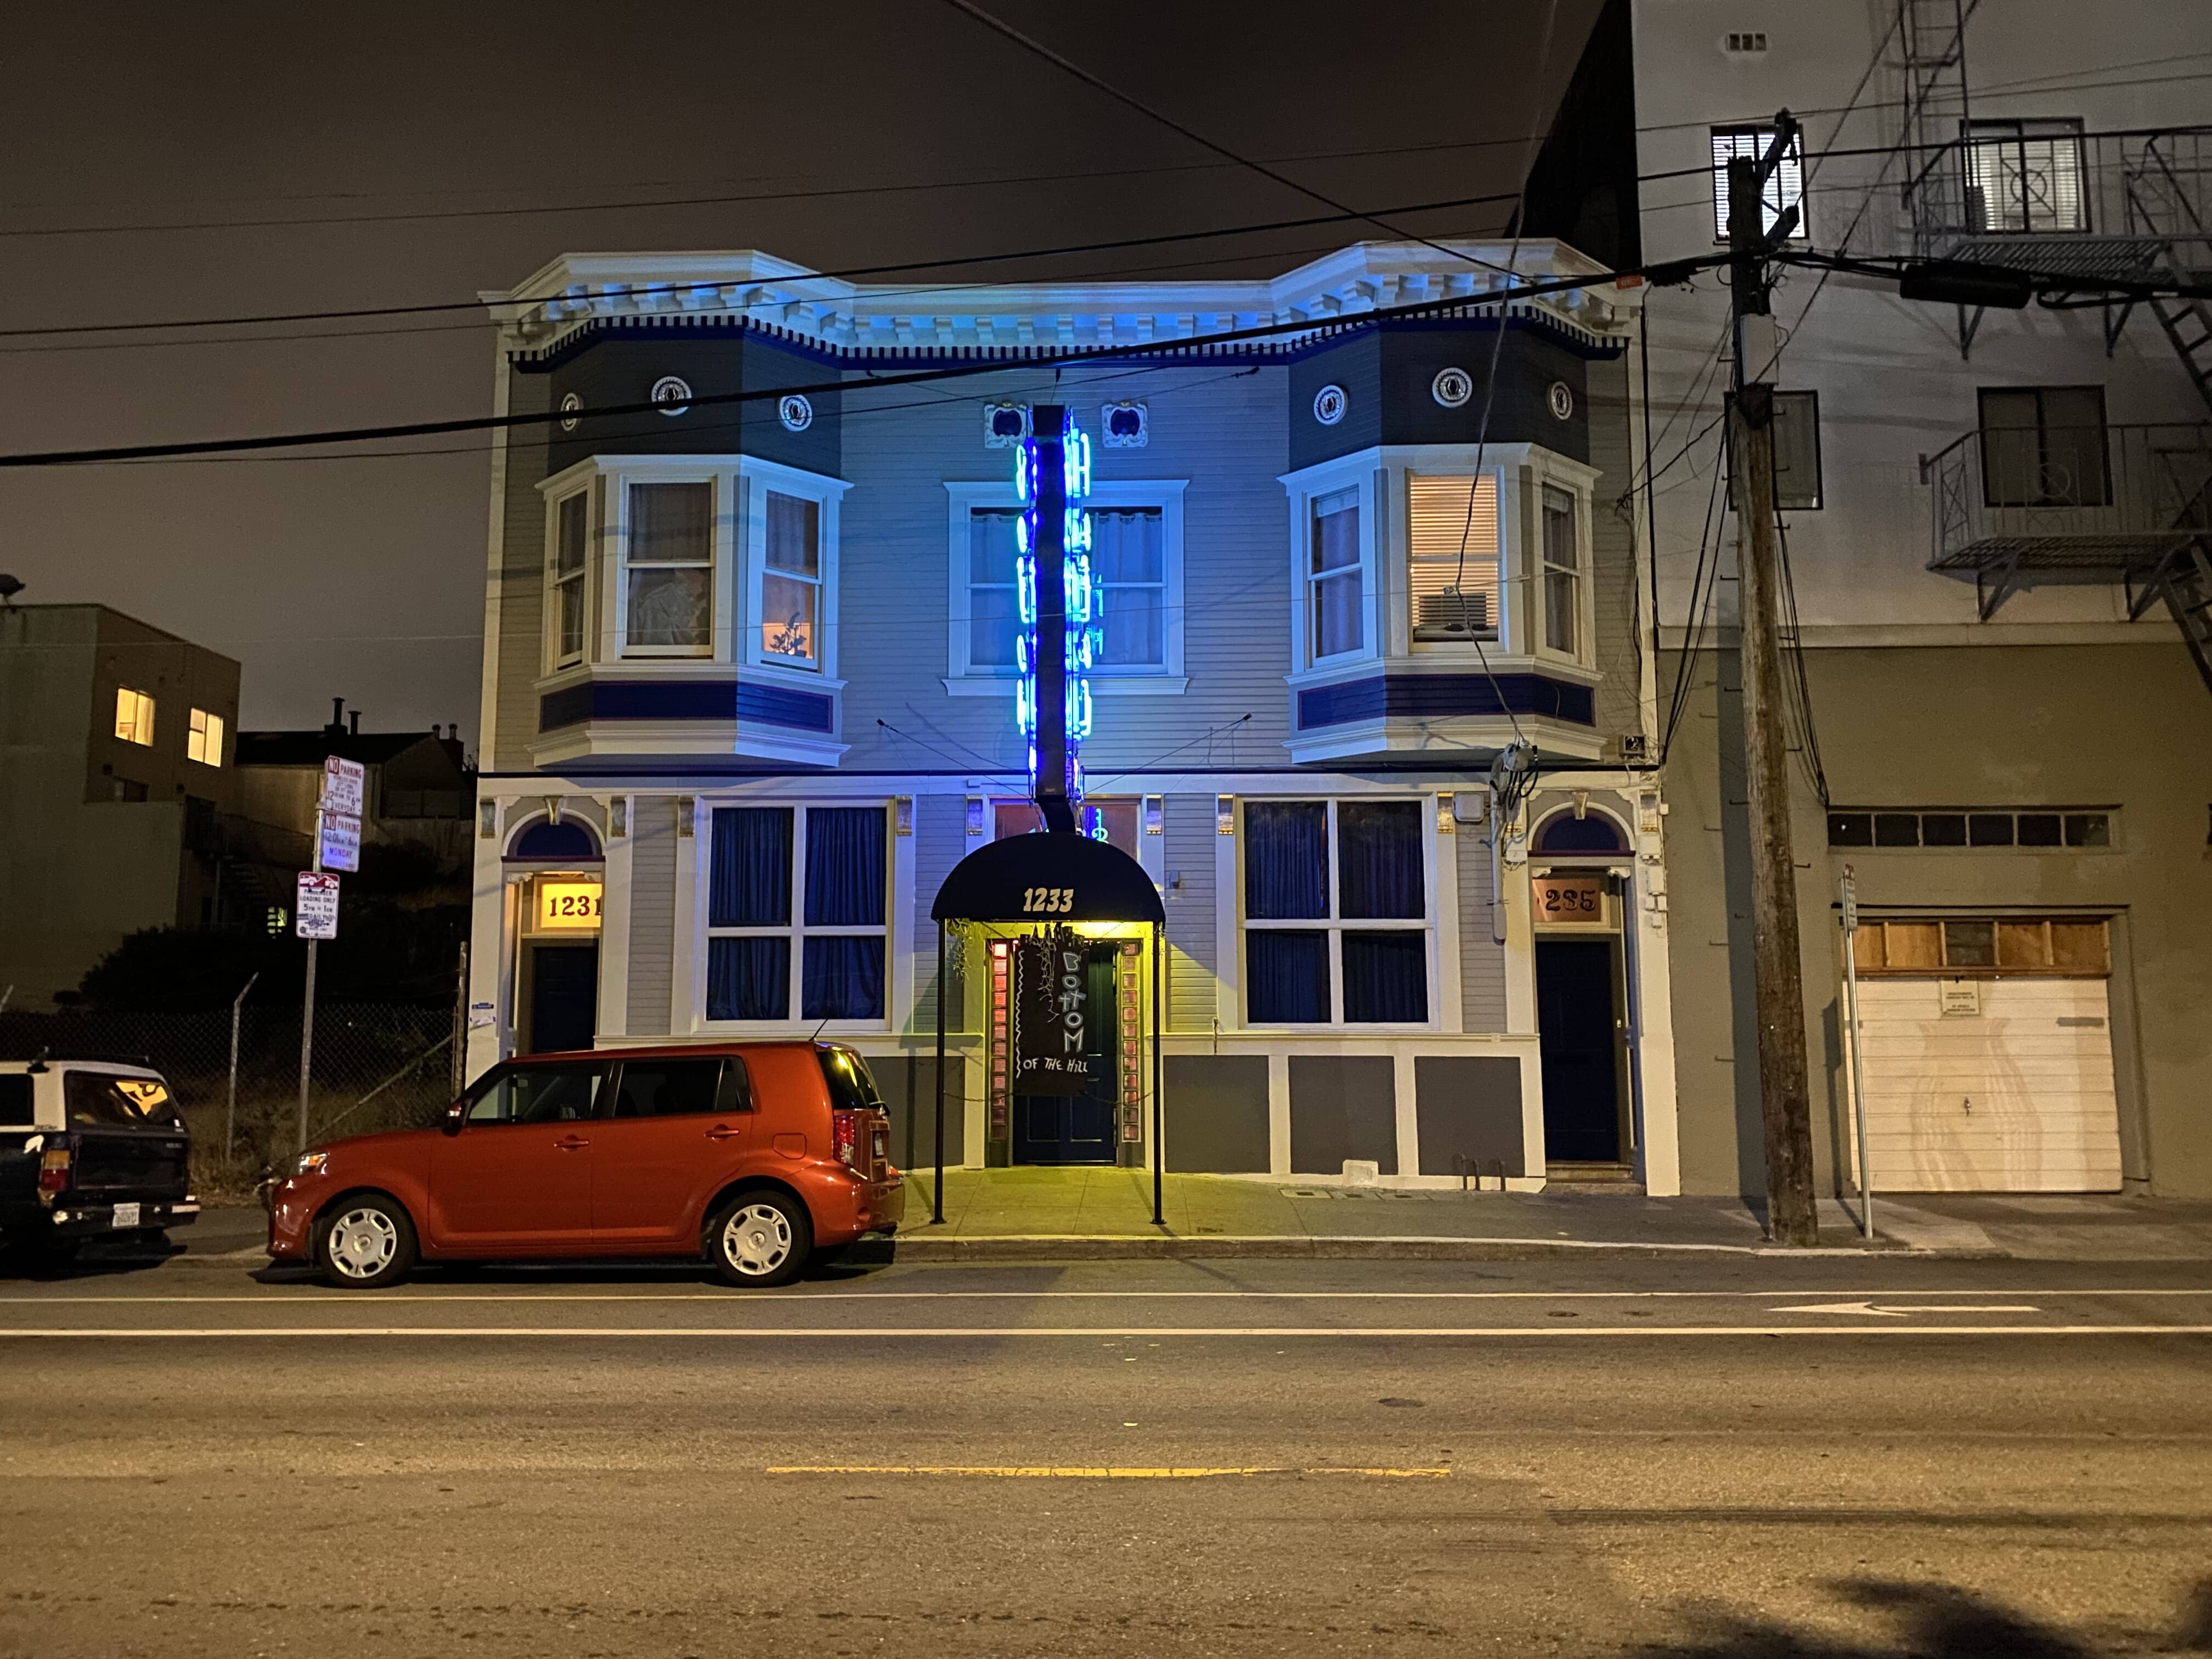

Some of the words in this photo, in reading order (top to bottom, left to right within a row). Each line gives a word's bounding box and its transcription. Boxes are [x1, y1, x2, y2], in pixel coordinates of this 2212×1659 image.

[329, 758, 338, 773] NO
[341, 764, 362, 779] PARKING
[325, 815, 336, 830] NO
[337, 820, 361, 834] PARKING
[329, 847, 353, 859] MONDAY
[1023, 887, 1074, 913] 1233
[1537, 888, 1596, 912] 235
[1023, 1058, 1039, 1070] OF
[1045, 1057, 1063, 1070] THE
[1066, 1058, 1088, 1073] HILL
